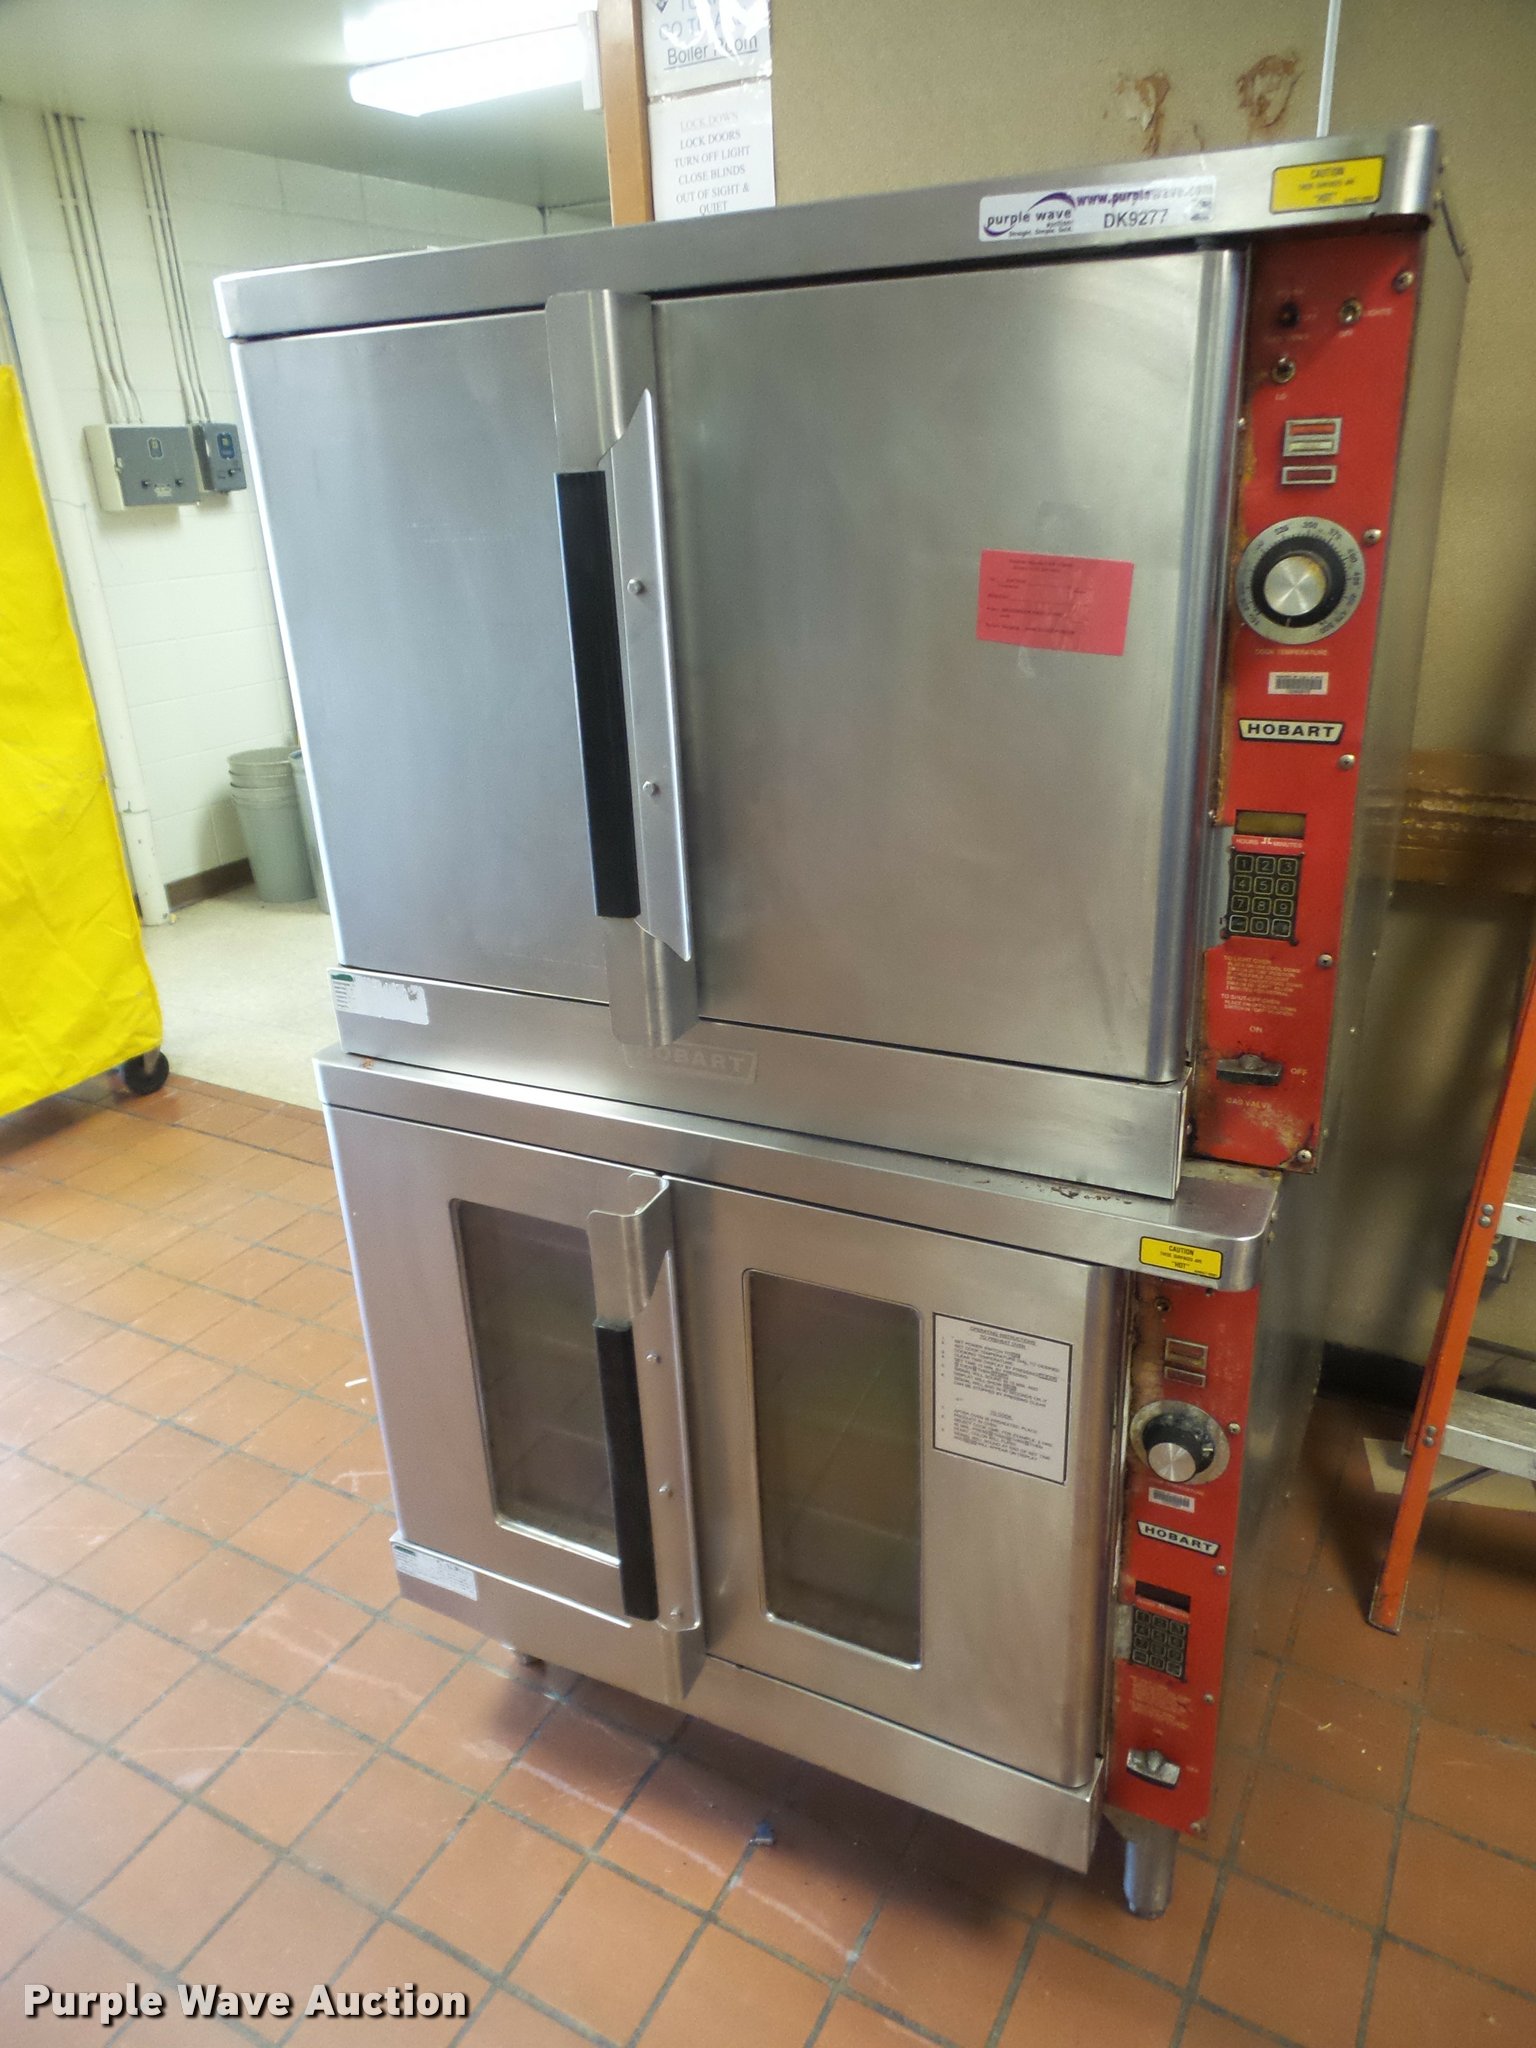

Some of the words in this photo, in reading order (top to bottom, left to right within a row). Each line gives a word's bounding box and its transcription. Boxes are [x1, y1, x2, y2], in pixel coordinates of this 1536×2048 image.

[667, 45, 708, 65] Boiler
[680, 136, 706, 150] LOCK
[708, 129, 741, 145] DOORS
[674, 155, 699, 168] TURN
[721, 145, 750, 160] LIGHT
[678, 171, 708, 185] CLOSE
[711, 164, 746, 179] BLINDS
[676, 192, 695, 204] OUT
[697, 189, 709, 200] OF
[712, 184, 740, 198] SIGHT
[742, 182, 750, 193] &
[699, 200, 727, 216] QUIET
[987, 211, 1030, 228] purple
[1035, 209, 1071, 221] wave
[1104, 208, 1168, 229] DK9277
[1247, 723, 1335, 738] HOBART
[1249, 1025, 1263, 1033] ON
[1168, 1245, 1194, 1256] CAUTION
[1144, 1525, 1212, 1552] HOBART
